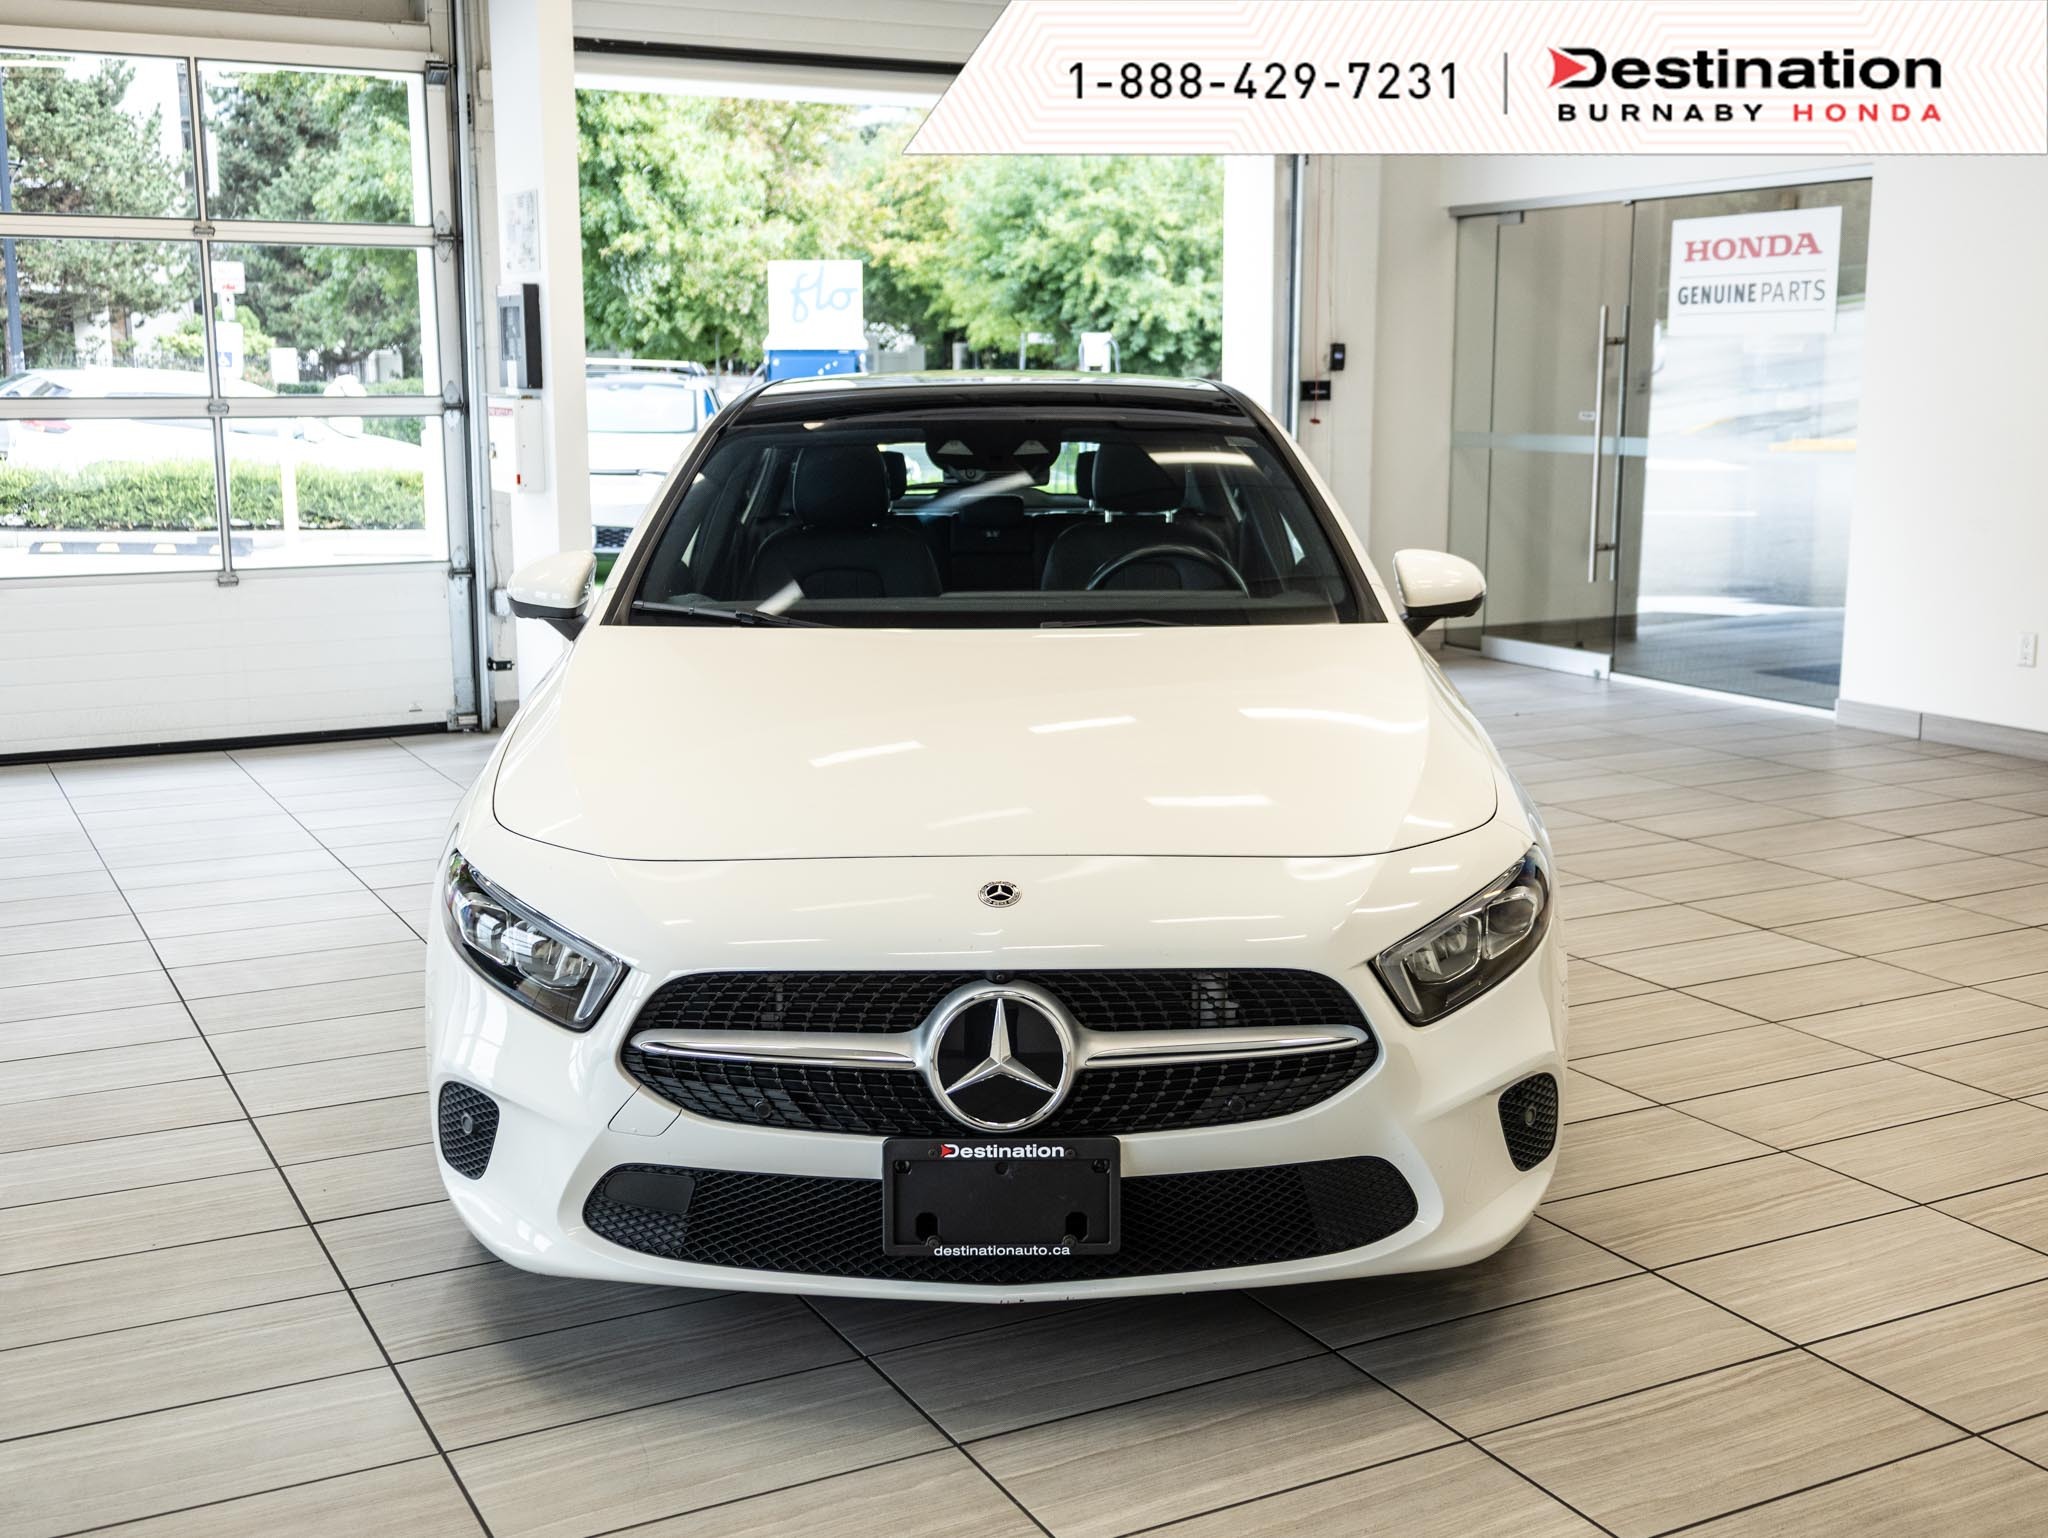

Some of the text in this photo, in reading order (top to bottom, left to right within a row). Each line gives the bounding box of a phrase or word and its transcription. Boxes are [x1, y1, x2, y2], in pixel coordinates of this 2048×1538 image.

[1684, 232, 1822, 262] HONDA
[790, 262, 858, 323] flo
[941, 1143, 1065, 1159] Destination
[933, 1244, 1071, 1257] destinationauto.ca
